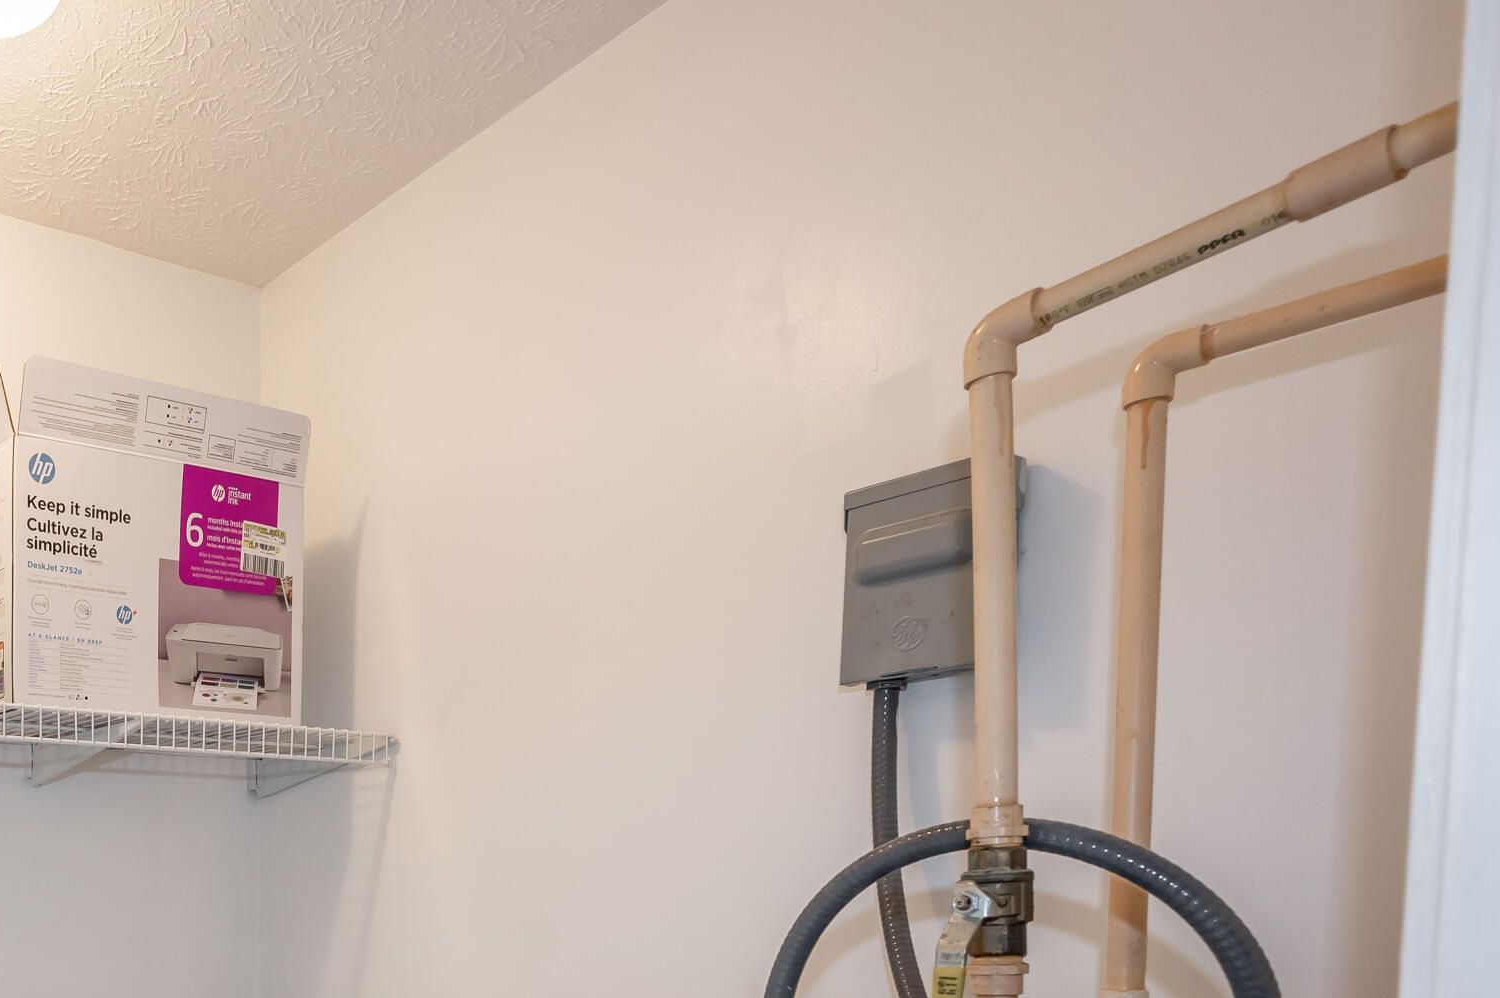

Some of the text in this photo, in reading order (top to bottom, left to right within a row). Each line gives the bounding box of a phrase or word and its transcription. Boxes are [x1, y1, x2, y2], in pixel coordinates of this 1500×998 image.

[1197, 228, 1247, 255] PPFA
[29, 453, 55, 484] hp
[27, 494, 131, 524] Keep it simple
[207, 517, 229, 526] months
[27, 517, 103, 542] Cultivez la
[186, 512, 204, 547] 6
[207, 534, 221, 542] mois
[27, 536, 97, 558] simplicité
[27, 561, 83, 576] DeskJet 2752e
